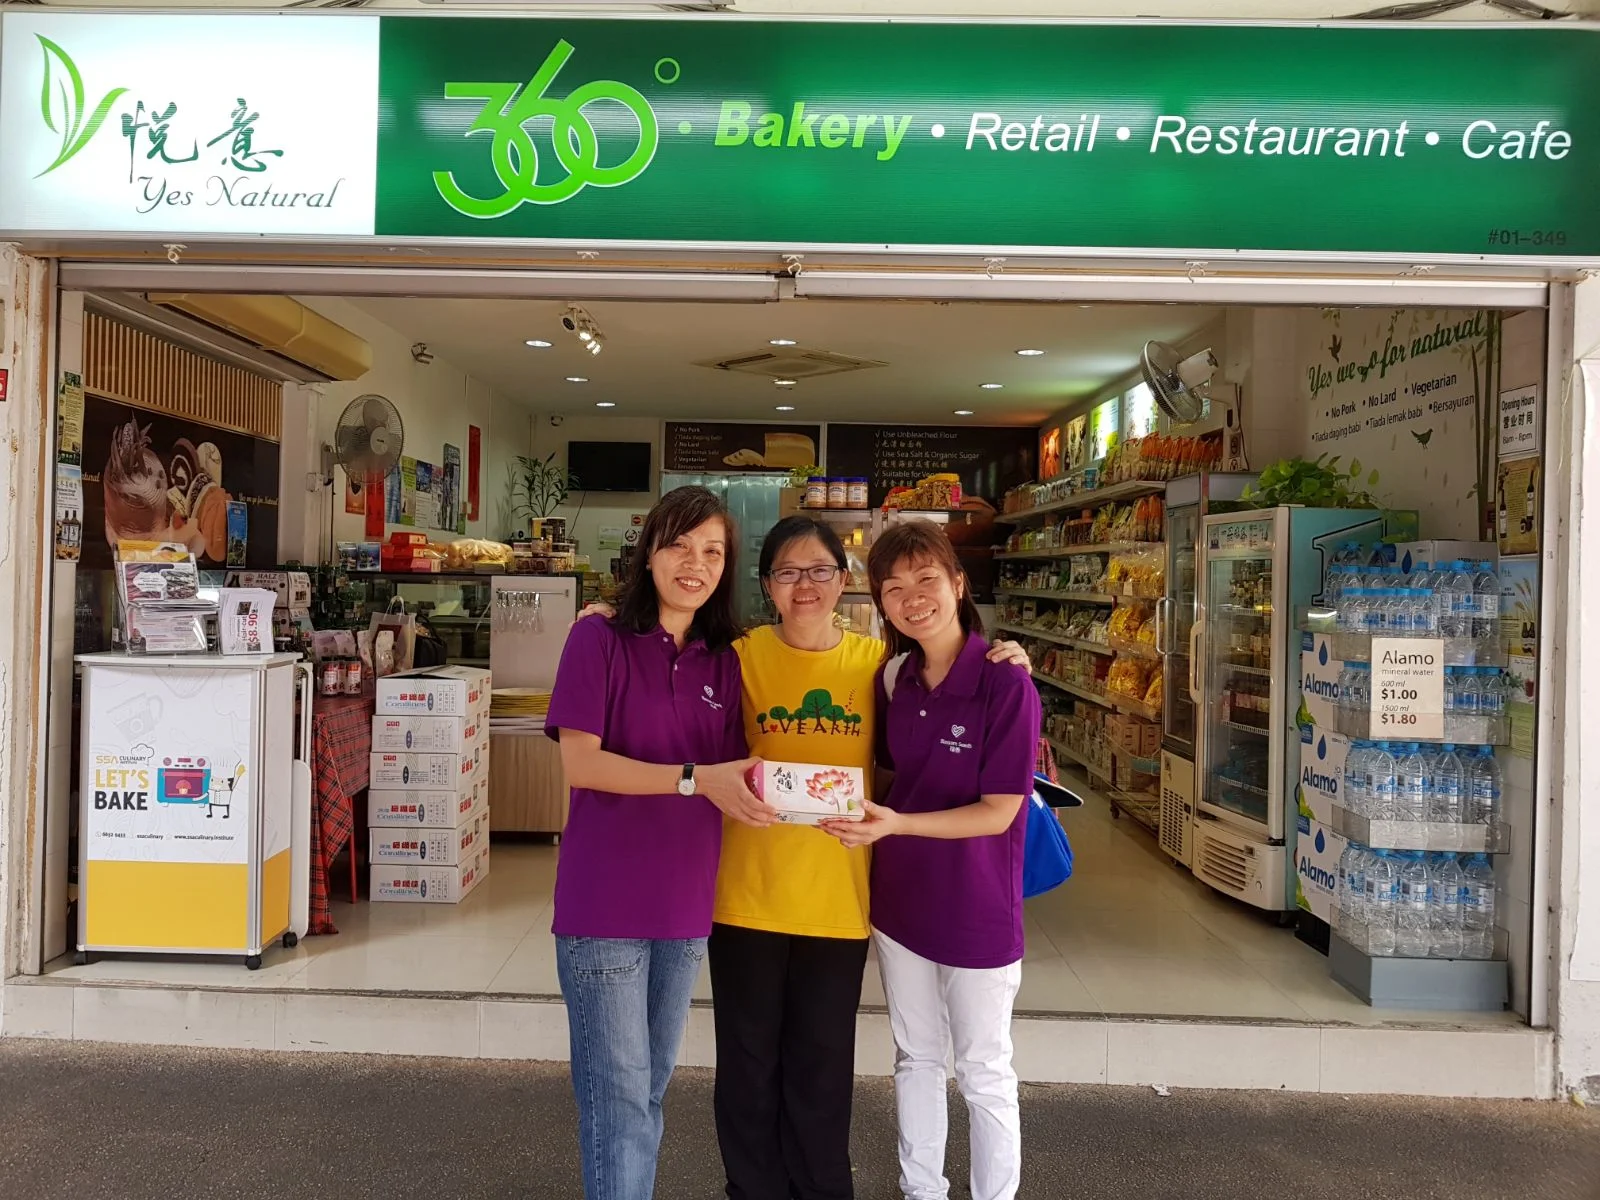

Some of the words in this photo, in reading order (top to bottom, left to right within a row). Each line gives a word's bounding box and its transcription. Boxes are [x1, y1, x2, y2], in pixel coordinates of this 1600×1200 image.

[714, 101, 913, 161] Bakery
[965, 113, 1101, 153] Retail
[1150, 115, 1409, 157] Restaurant
[1461, 119, 1572, 161] Cafe
[136, 174, 193, 213] Yes
[206, 176, 346, 209] Natural
[1487, 229, 1567, 247] #01-349
[1309, 362, 1332, 400] Yes
[1337, 362, 1355, 384] we
[1378, 337, 1406, 379] for
[1411, 311, 1485, 359] natural
[1331, 407, 1340, 418] No
[1341, 402, 1356, 416] Pork
[1368, 395, 1378, 408] No
[1380, 388, 1397, 405] Lard
[1411, 373, 1457, 397] Vegetarian
[1501, 399, 1520, 412] Opening
[1521, 396, 1535, 407] Hours
[1369, 417, 1385, 429] Tiada
[1386, 410, 1407, 425] lemak
[1407, 406, 1423, 421] babi
[1432, 394, 1475, 415] Bersayuran
[931, 451, 958, 460] Organic
[959, 452, 979, 460] Sugar
[881, 470, 910, 478] Suitable
[1382, 650, 1434, 666] Alamo
[1381, 668, 1411, 676] mineral
[1304, 673, 1339, 699] Alamo
[1381, 690, 1417, 700] $1.00
[1381, 714, 1416, 724] $1.80
[95, 769, 149, 789] LET'S
[1302, 766, 1337, 794] Alamo
[94, 791, 148, 810] BAKE
[1299, 855, 1336, 890] Alamo
